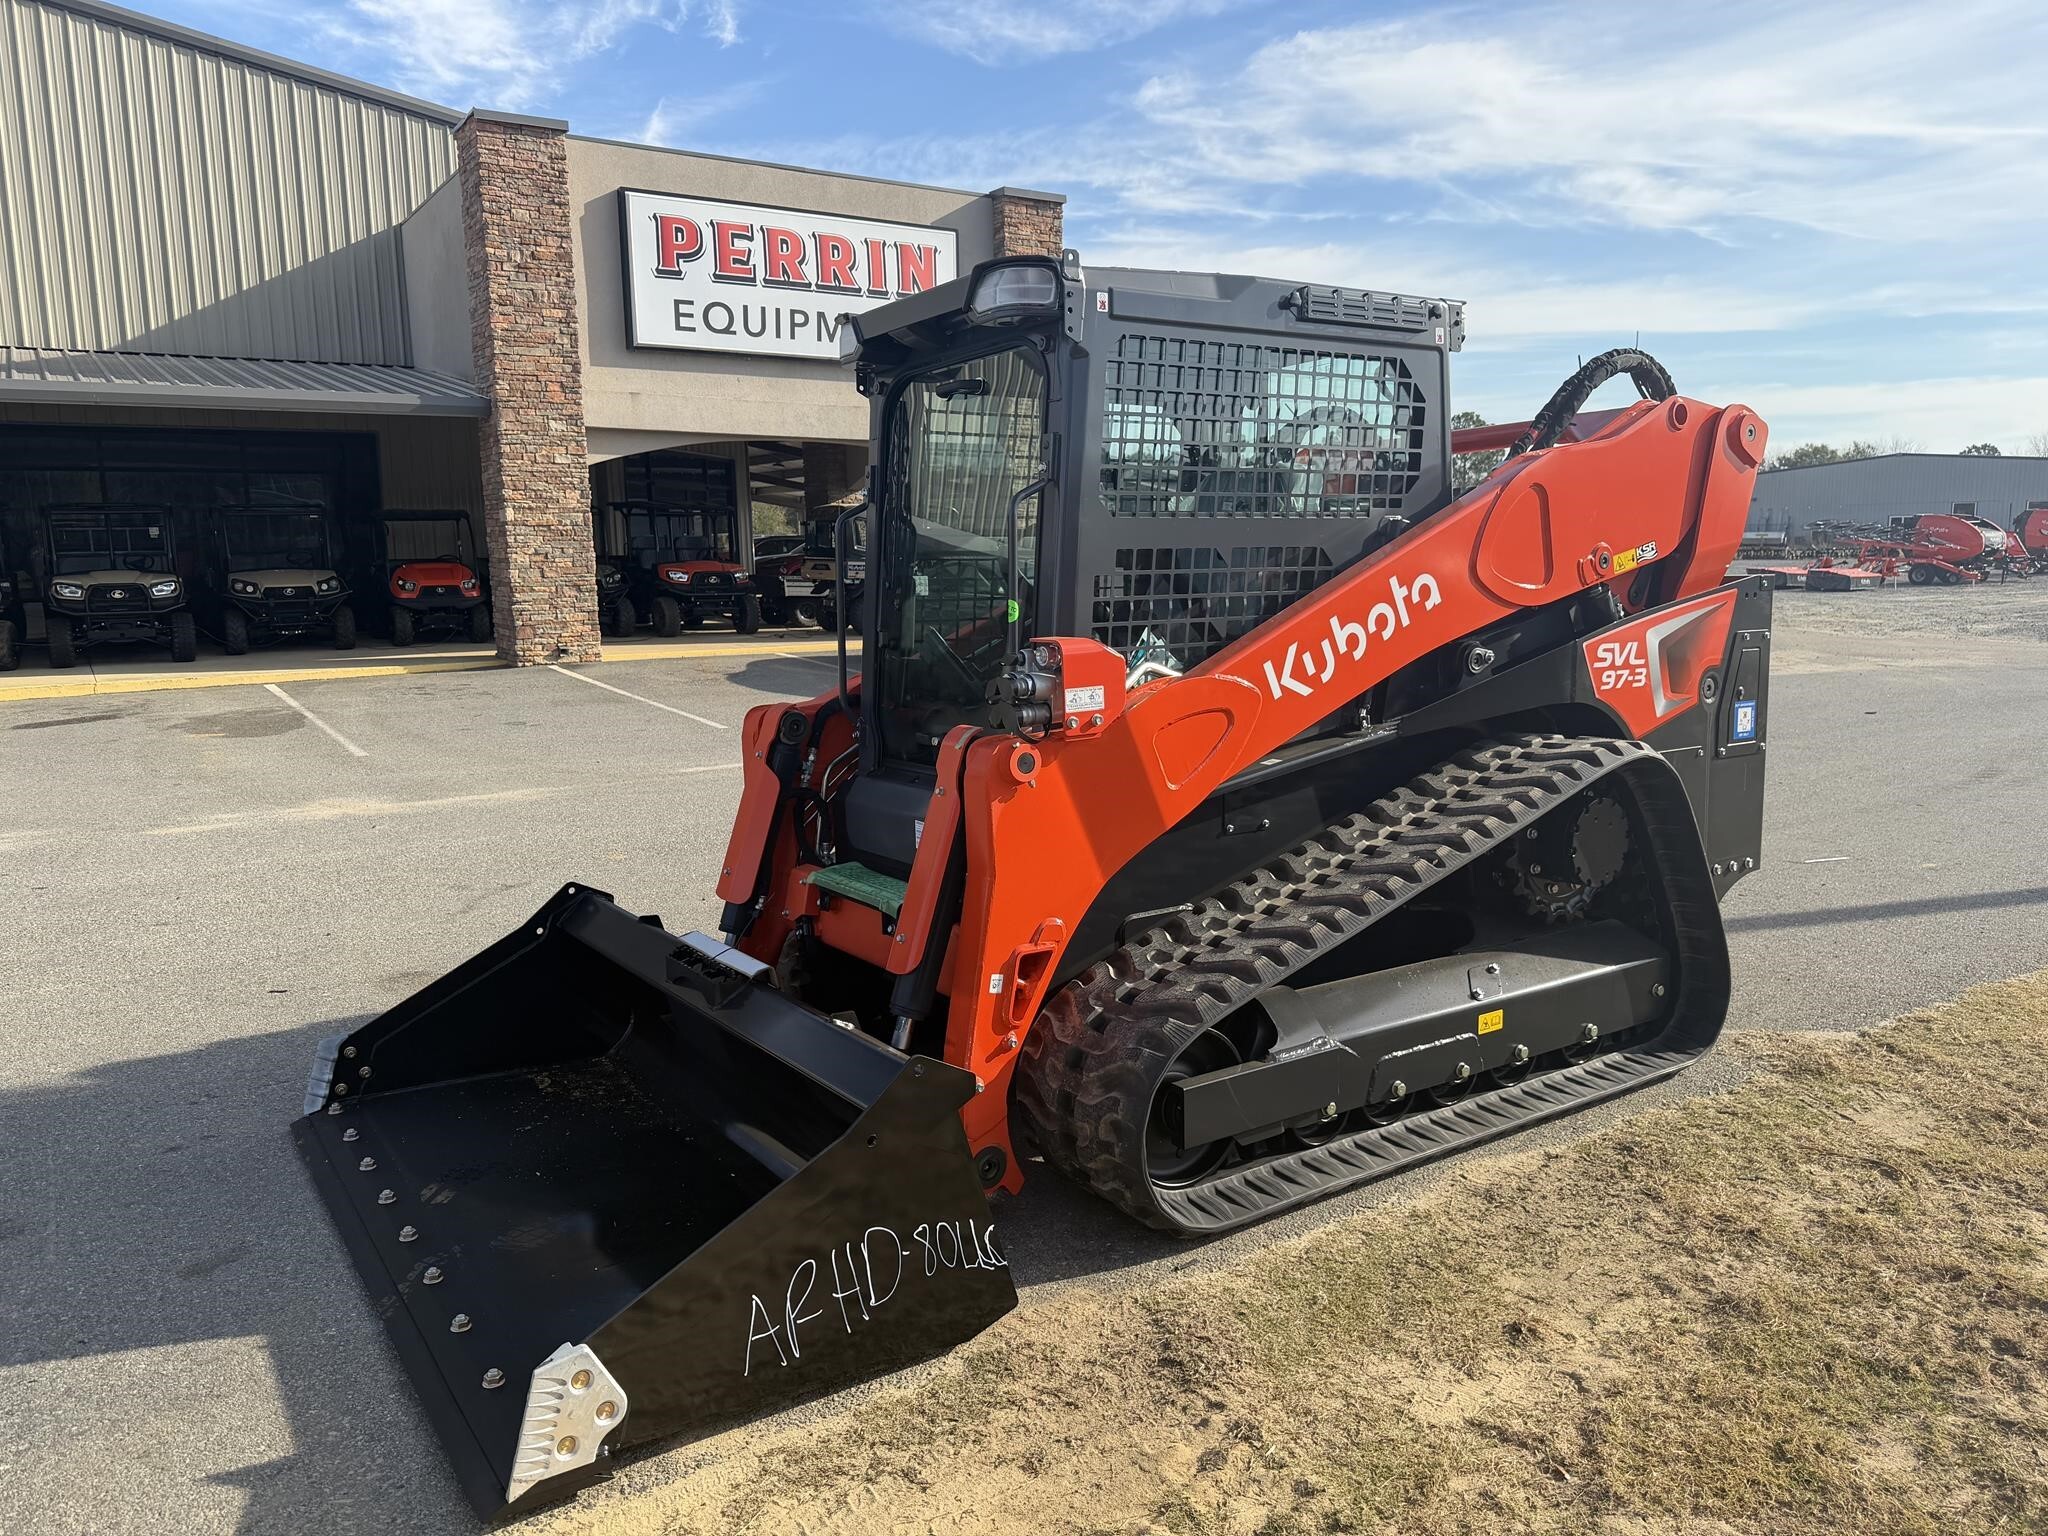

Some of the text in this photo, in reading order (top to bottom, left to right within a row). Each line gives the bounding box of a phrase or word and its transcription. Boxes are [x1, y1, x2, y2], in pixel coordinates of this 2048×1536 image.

[650, 212, 941, 301] PERRIN
[1636, 540, 1656, 557] KSR
[1261, 571, 1443, 701] Kubota
[1592, 641, 1647, 668] SVL
[1600, 667, 1648, 691] 97-3
